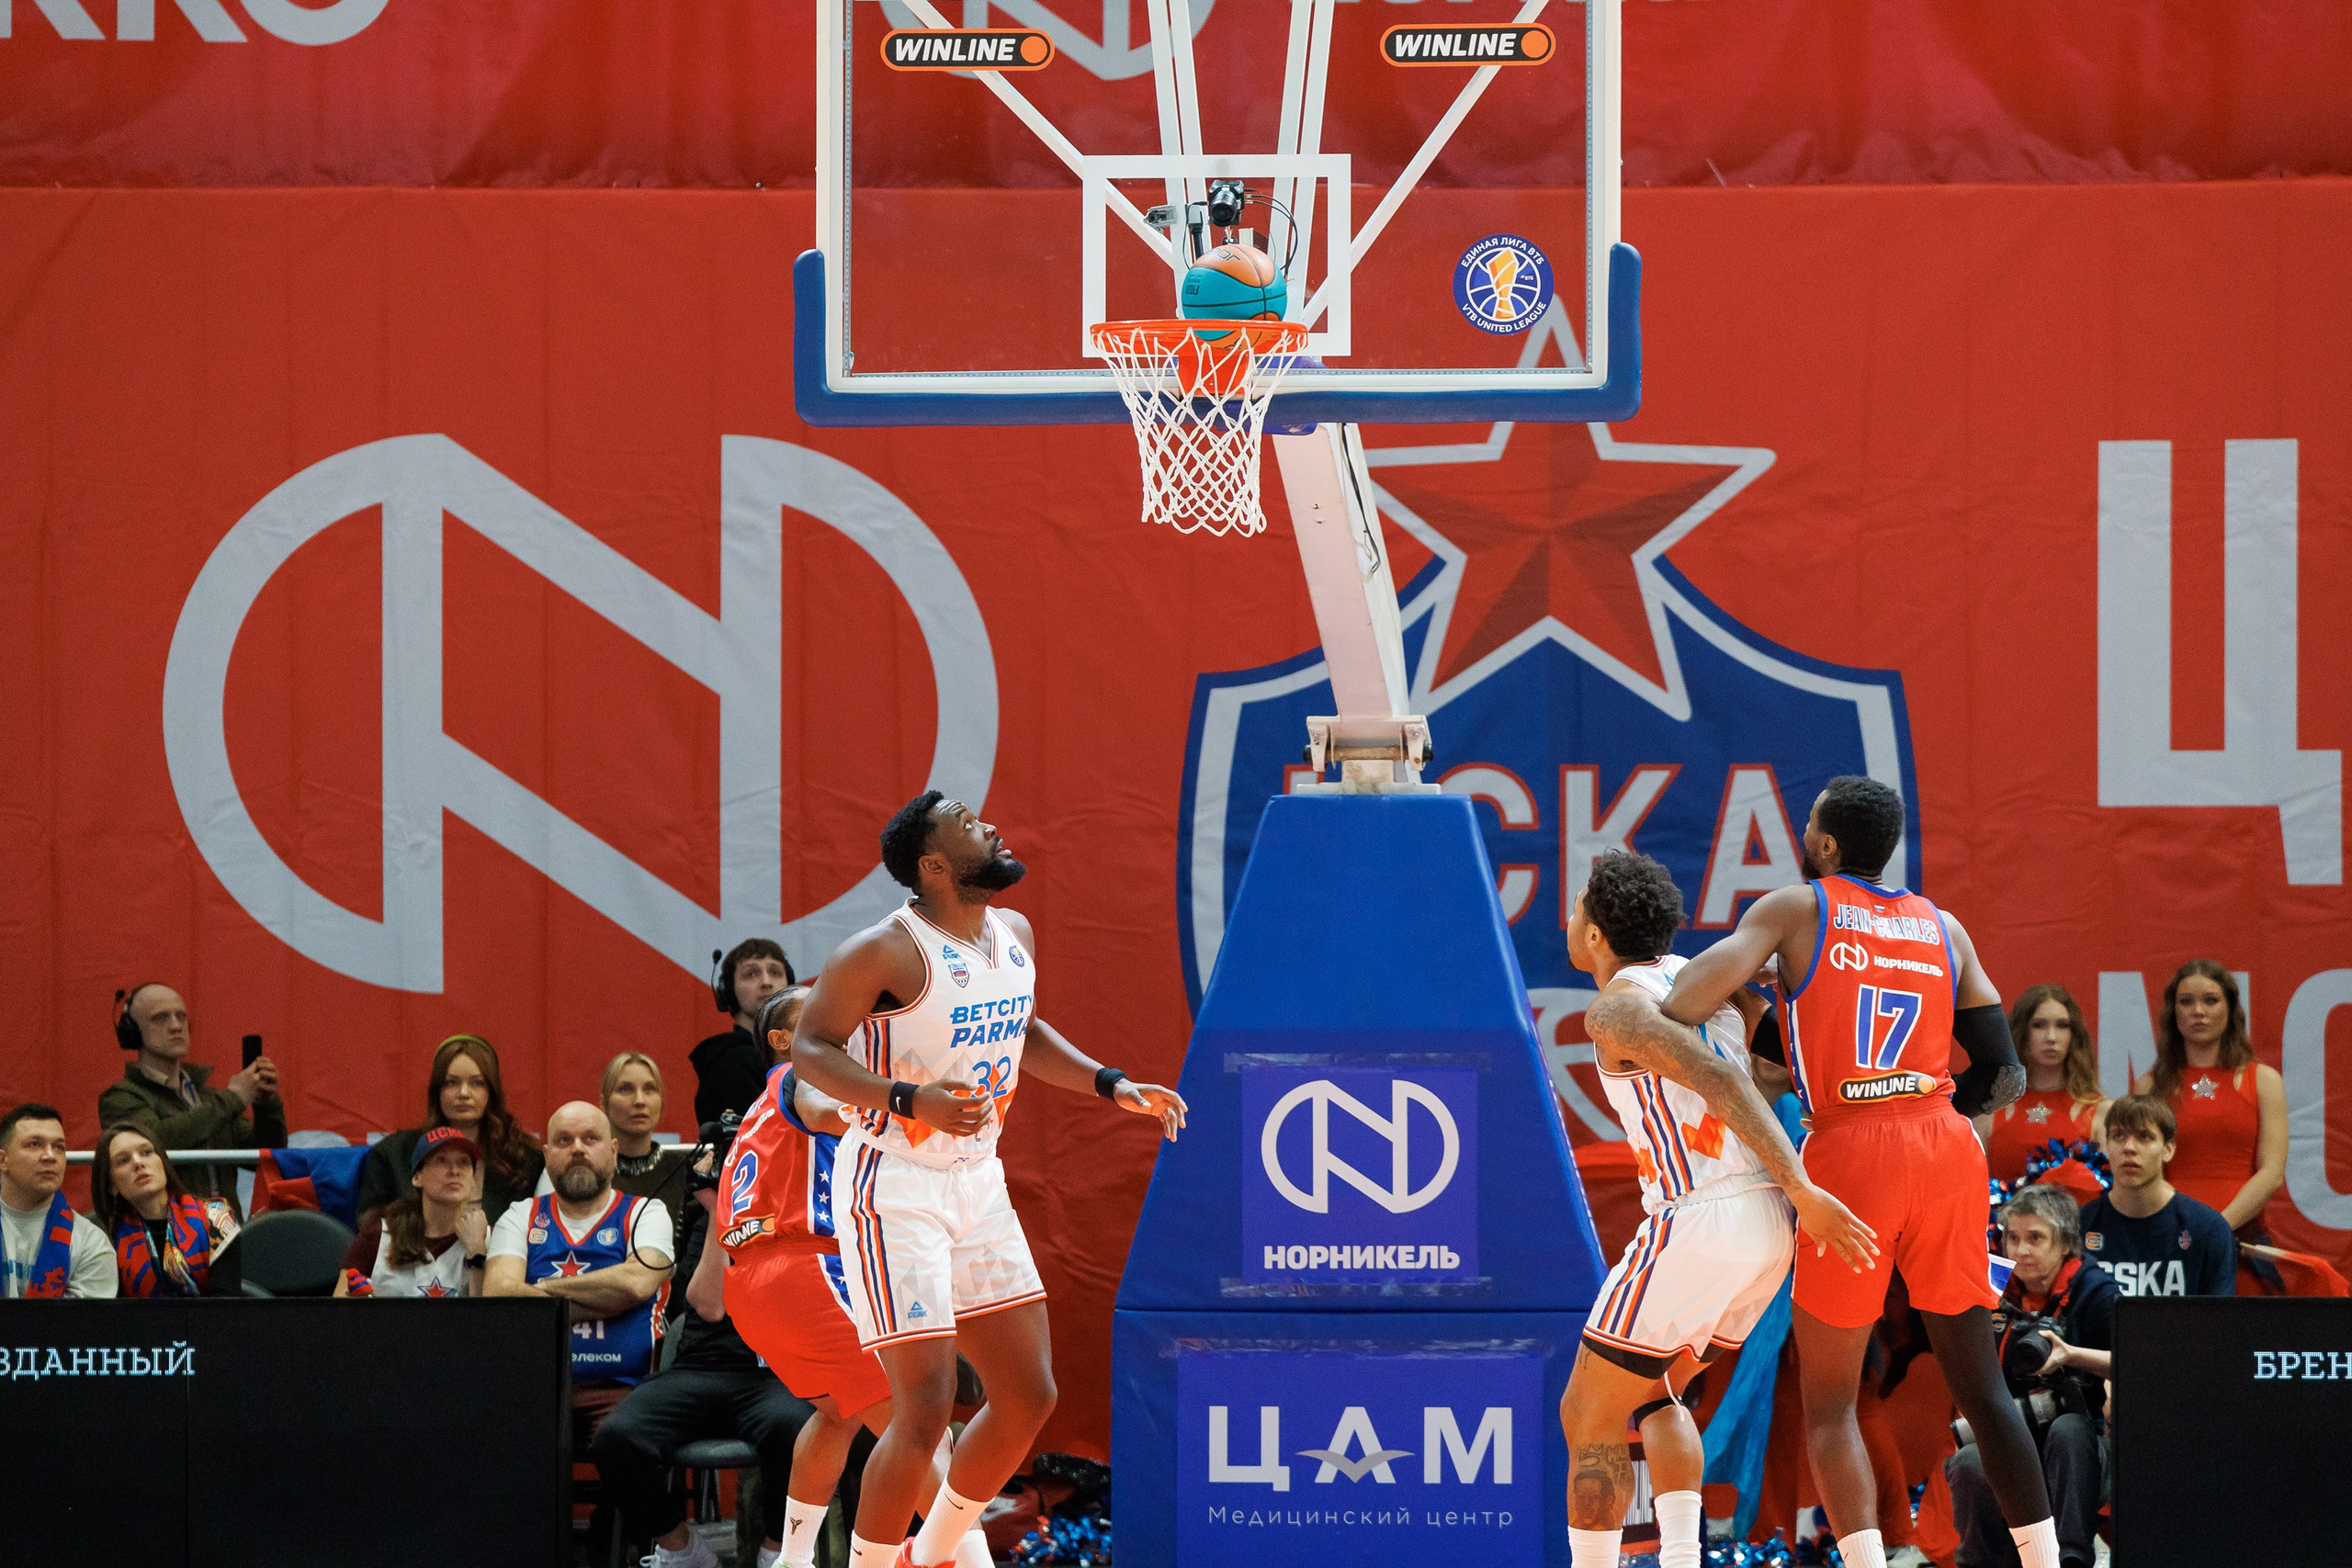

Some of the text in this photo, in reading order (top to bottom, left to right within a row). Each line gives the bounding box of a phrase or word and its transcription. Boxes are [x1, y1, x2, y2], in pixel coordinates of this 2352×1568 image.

[895, 38, 1017, 62] WINLINE
[1395, 32, 1518, 57] WINLINE
[1461, 237, 1545, 268] ЕДИНАЯ ЛИГА ВТБ
[1462, 301, 1547, 333] VTB UNITED LEAGUE
[1283, 762, 1809, 931] СКА
[1833, 903, 1940, 946] JEAN-CHARLES
[1873, 954, 1944, 977] НОРНИКЕЛЬ
[949, 992, 1034, 1025] BETCITY
[949, 1015, 1030, 1049] PARMA
[1855, 983, 1923, 1071] 17
[971, 1055, 1012, 1100] 32
[1846, 1077, 1917, 1099] WINLINE
[1262, 1244, 1461, 1270] НОРНИКЕЛЬ
[2253, 1351, 2352, 1380] БРЕН
[1208, 1404, 1513, 1493] ЦАМ
[1207, 1506, 1514, 1529] Медицинский центр
